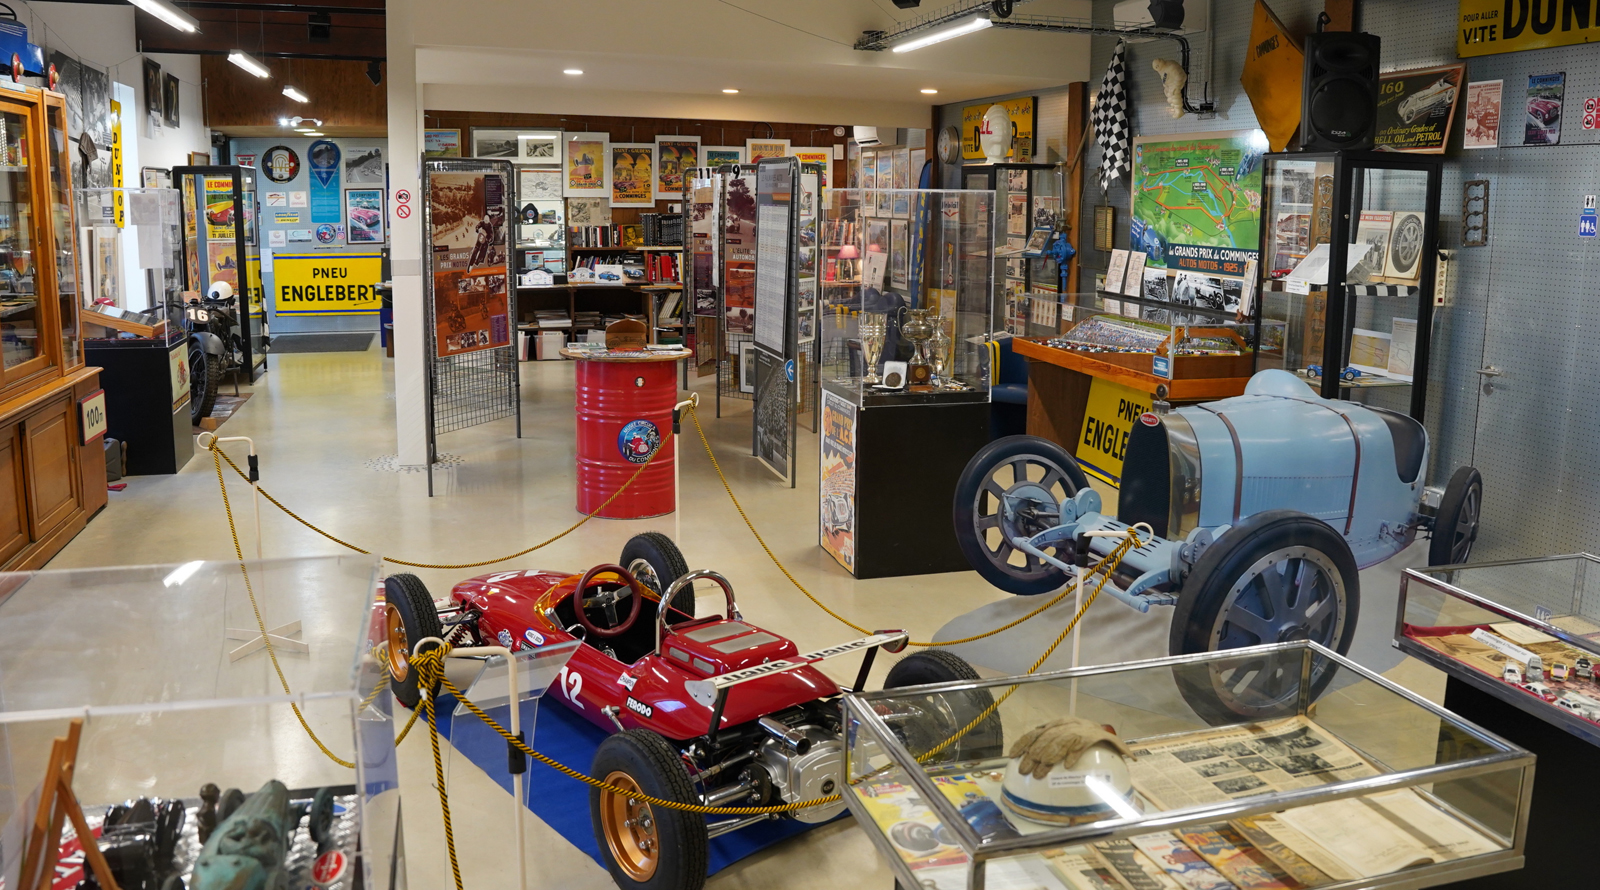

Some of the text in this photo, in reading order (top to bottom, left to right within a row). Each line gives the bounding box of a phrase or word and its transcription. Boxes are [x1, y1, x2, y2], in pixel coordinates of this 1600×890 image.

[1463, 10, 1499, 23] POUR ALLER
[1463, 0, 1600, 45] VITE DUN
[1379, 81, 1405, 95] 160
[1387, 126, 1410, 136] Ordinary
[1410, 124, 1429, 133] Grades
[1429, 123, 1437, 131] of
[1375, 135, 1393, 144] HELL
[1394, 134, 1406, 143] OIL
[1415, 132, 1443, 142] PETROL
[698, 168, 710, 179] 11
[733, 165, 740, 179] 9
[450, 252, 470, 260] GRANDS
[1174, 246, 1198, 258] GRANDS
[1198, 248, 1213, 259] PRIX
[440, 261, 452, 269] PRIX
[1178, 258, 1197, 269] AUTOS
[1198, 260, 1218, 271] MOTOS
[1223, 262, 1238, 273] 1925
[313, 267, 348, 279] PNEU
[281, 285, 377, 302] ENGLEBERT
[187, 308, 209, 322] 16
[1141, 414, 1158, 424] BUGATTI
[560, 665, 585, 710] 12
[626, 696, 653, 718] FERODO
